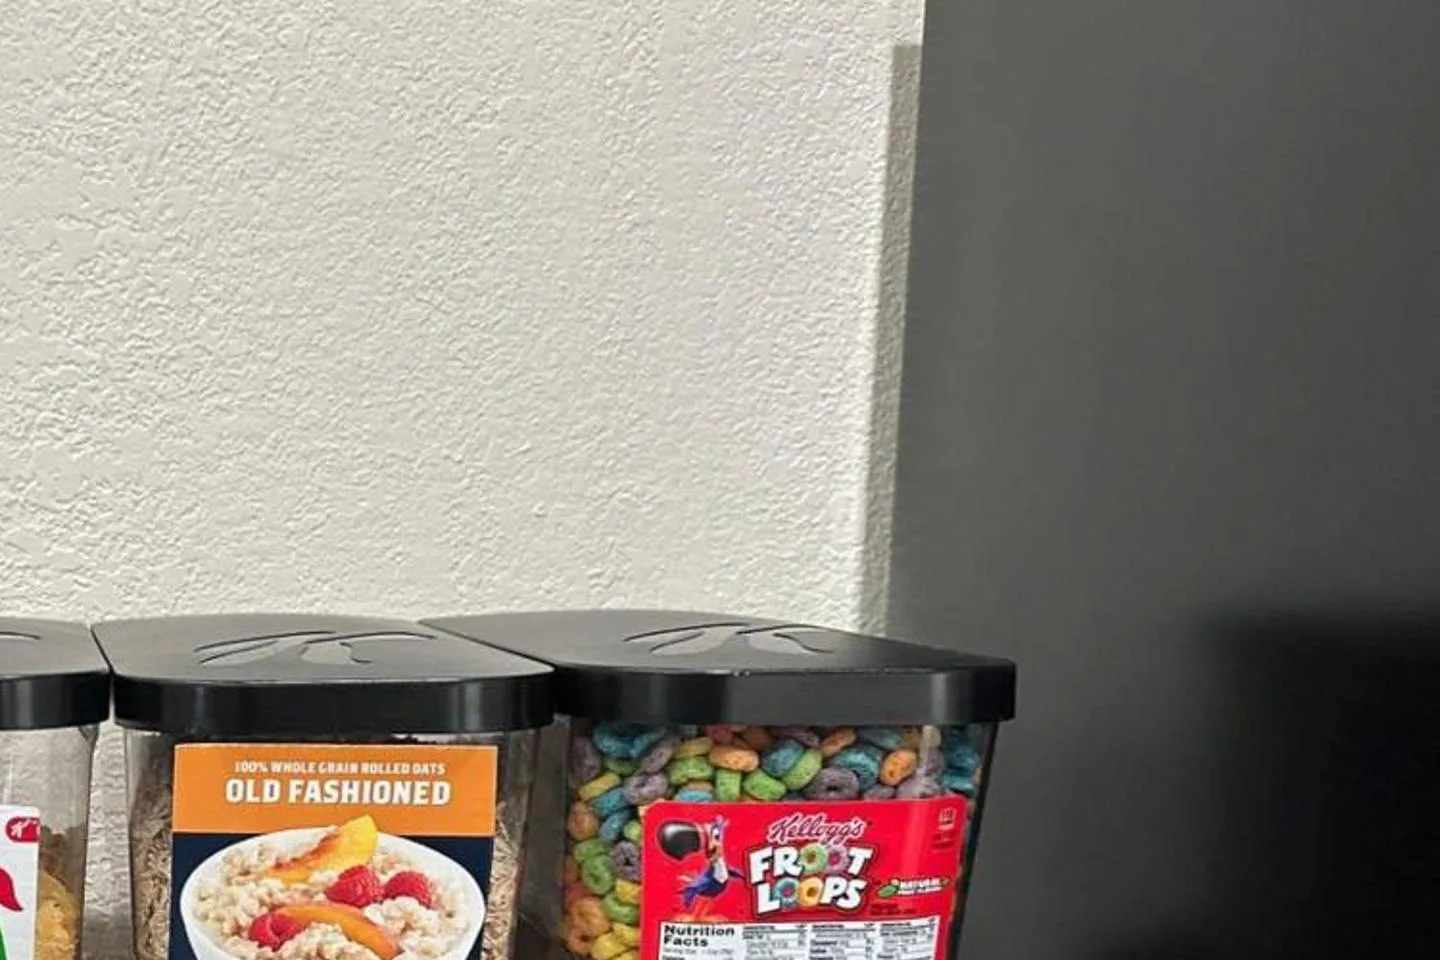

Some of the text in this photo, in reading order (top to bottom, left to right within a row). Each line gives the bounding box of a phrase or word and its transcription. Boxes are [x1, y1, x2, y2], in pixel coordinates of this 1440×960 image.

[234, 761, 446, 775] 100% WHOLE GRAIN ROLLED OATS
[225, 778, 452, 806] OLD FASHIONED
[766, 811, 867, 850] Kellogg's
[748, 842, 875, 885] FROOT
[756, 876, 868, 915] LOOPS
[663, 924, 736, 938] Nutrition
[663, 934, 709, 948] Facts
